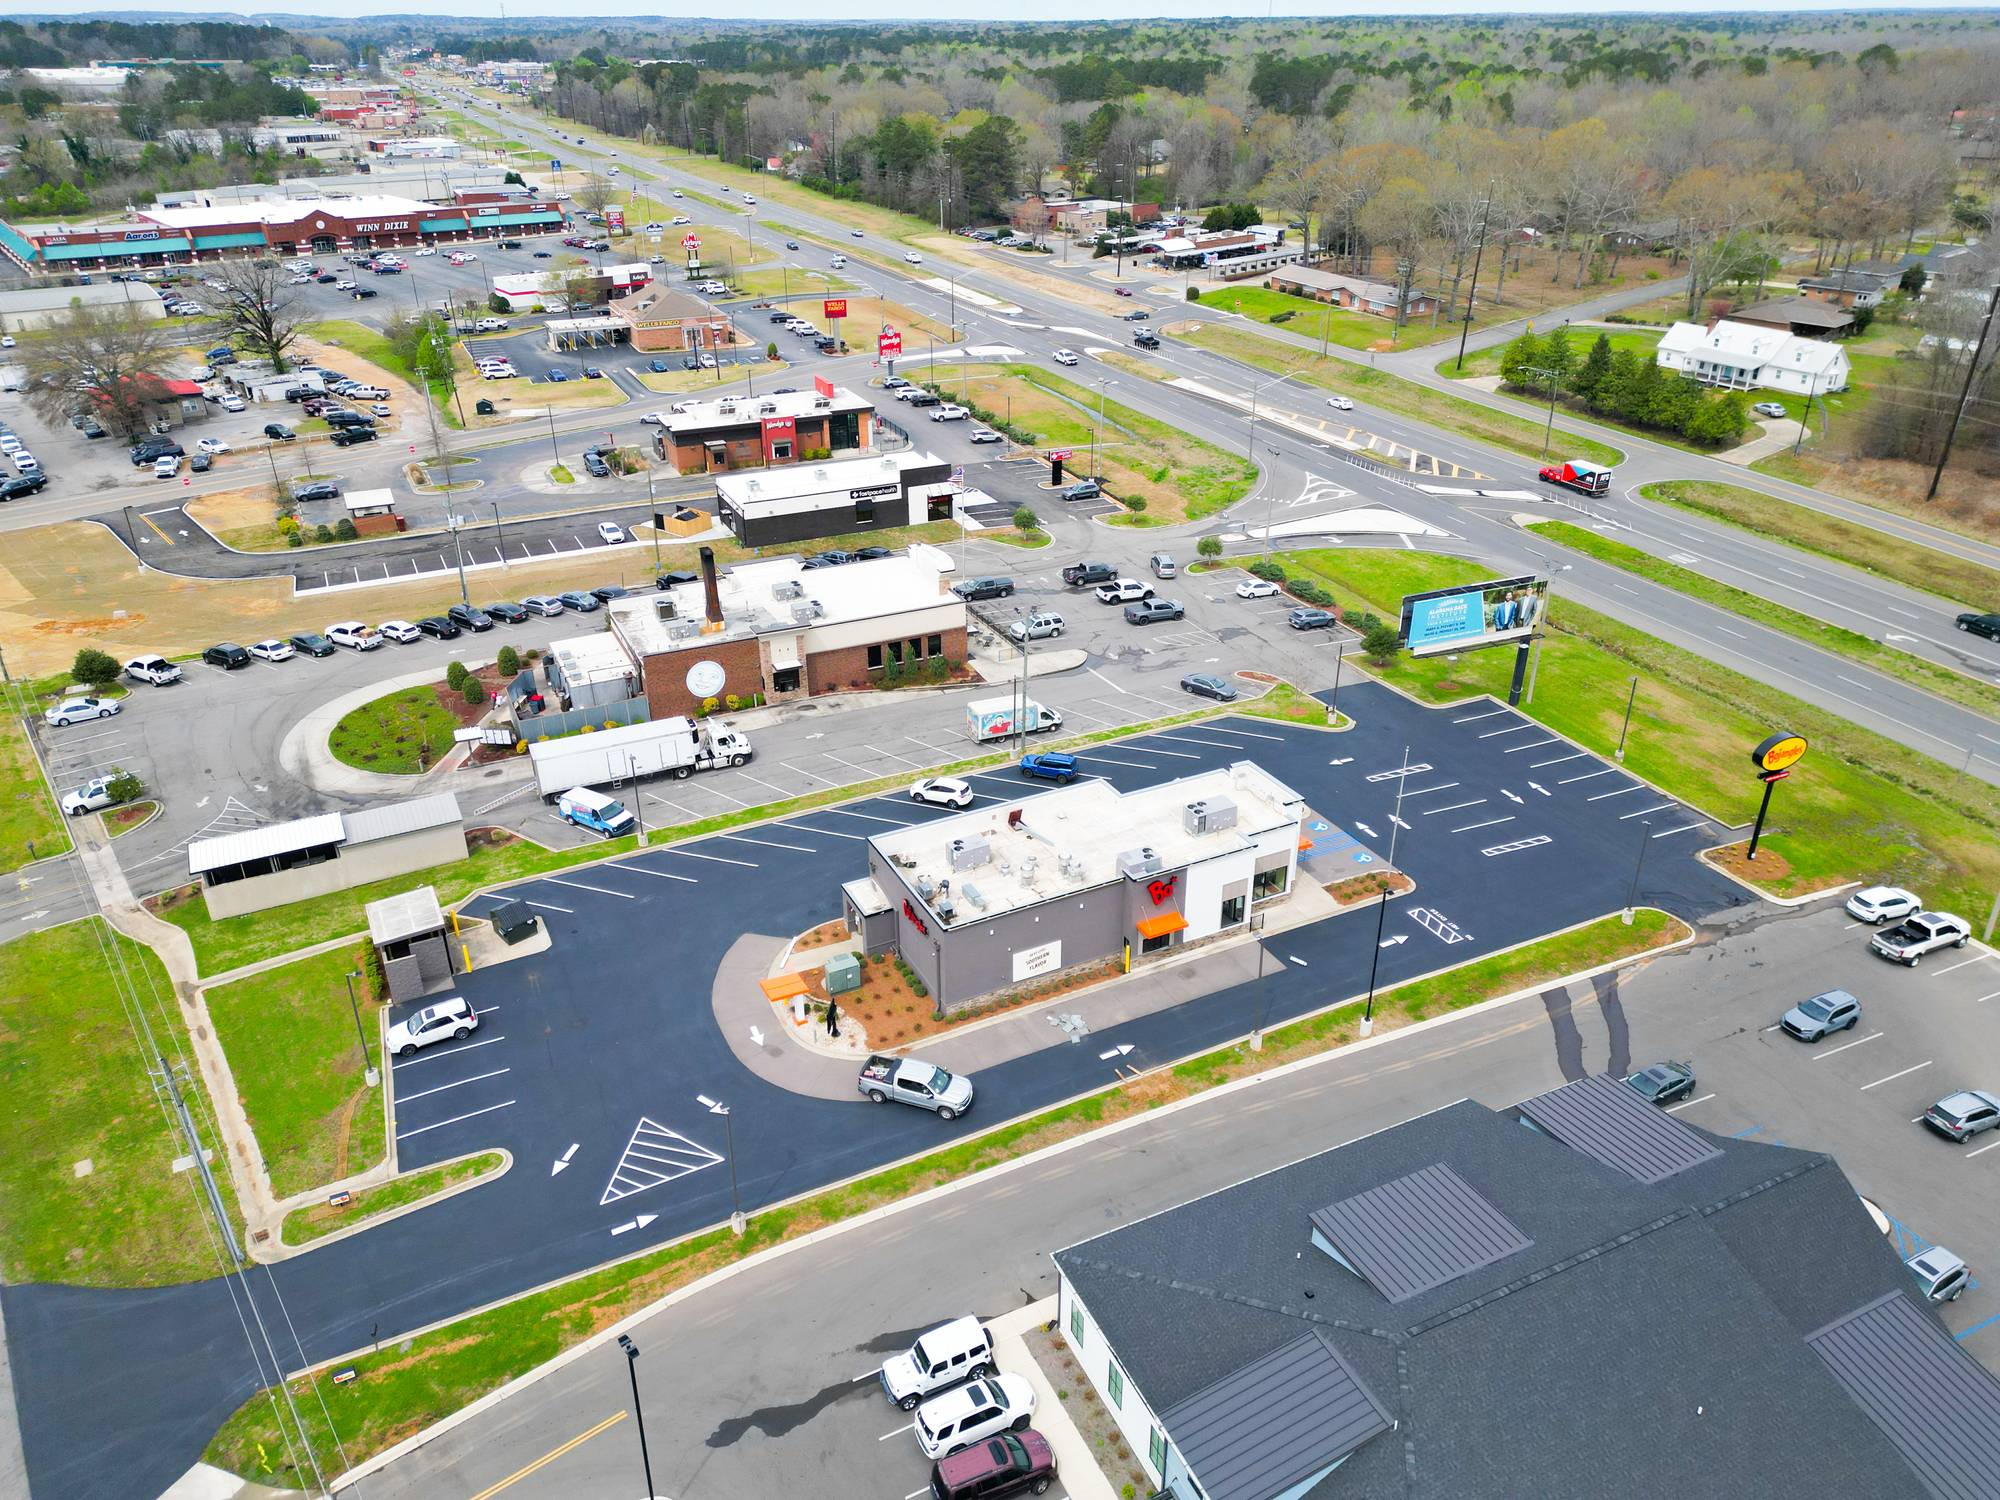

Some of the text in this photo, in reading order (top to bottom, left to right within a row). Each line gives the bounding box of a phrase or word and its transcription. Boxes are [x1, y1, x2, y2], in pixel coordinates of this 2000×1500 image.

[356, 221, 409, 233] WINN DIXIE
[637, 319, 681, 328] WELLS FARGO
[1429, 908, 1448, 922] ENTER
[1447, 922, 1461, 931] NOT
[1025, 951, 1050, 966] SOUTHERN
[1029, 960, 1047, 971] FLAVOR
